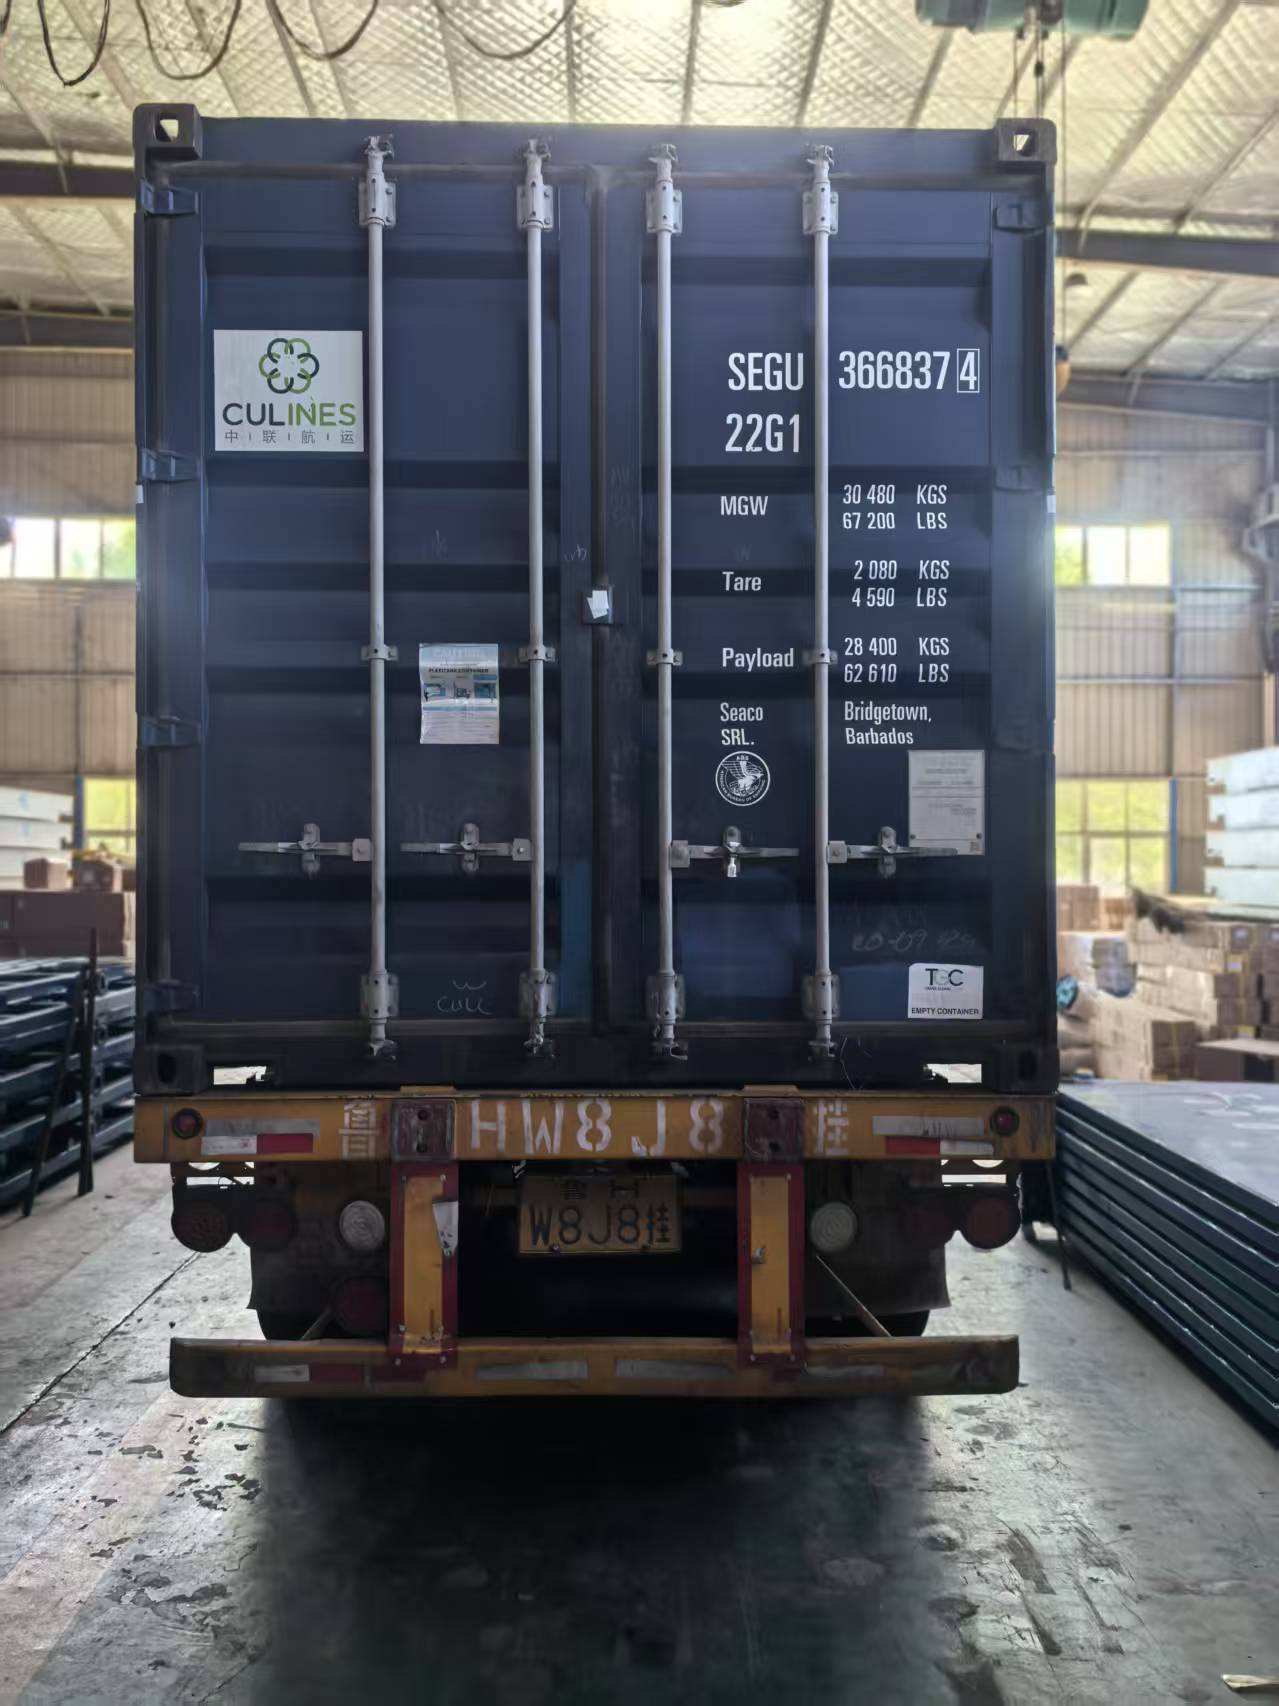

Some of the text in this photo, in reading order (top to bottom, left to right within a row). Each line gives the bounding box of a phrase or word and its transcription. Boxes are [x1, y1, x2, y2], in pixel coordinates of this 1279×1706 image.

[728, 352, 804, 391] SEGU
[222, 402, 357, 427] CULINES
[725, 413, 800, 453] 22G1
[843, 484, 948, 505] 30 480 KGS
[720, 495, 769, 516] MGW
[843, 511, 948, 530] 67 200 LBS
[853, 560, 951, 580] 2 080 KGS
[722, 571, 762, 592] Tare
[851, 587, 948, 608] 4 590 LBS
[844, 637, 951, 657] 28 400 KGS
[722, 647, 795, 673] Payload
[844, 663, 950, 684] 62 610 LBS
[720, 702, 764, 722] Seaco
[844, 700, 932, 725] Bridgetown,
[721, 728, 755, 746] SRL.
[845, 727, 914, 745] Barbados
[911, 1007, 979, 1015] EMPTY CONTAINER
